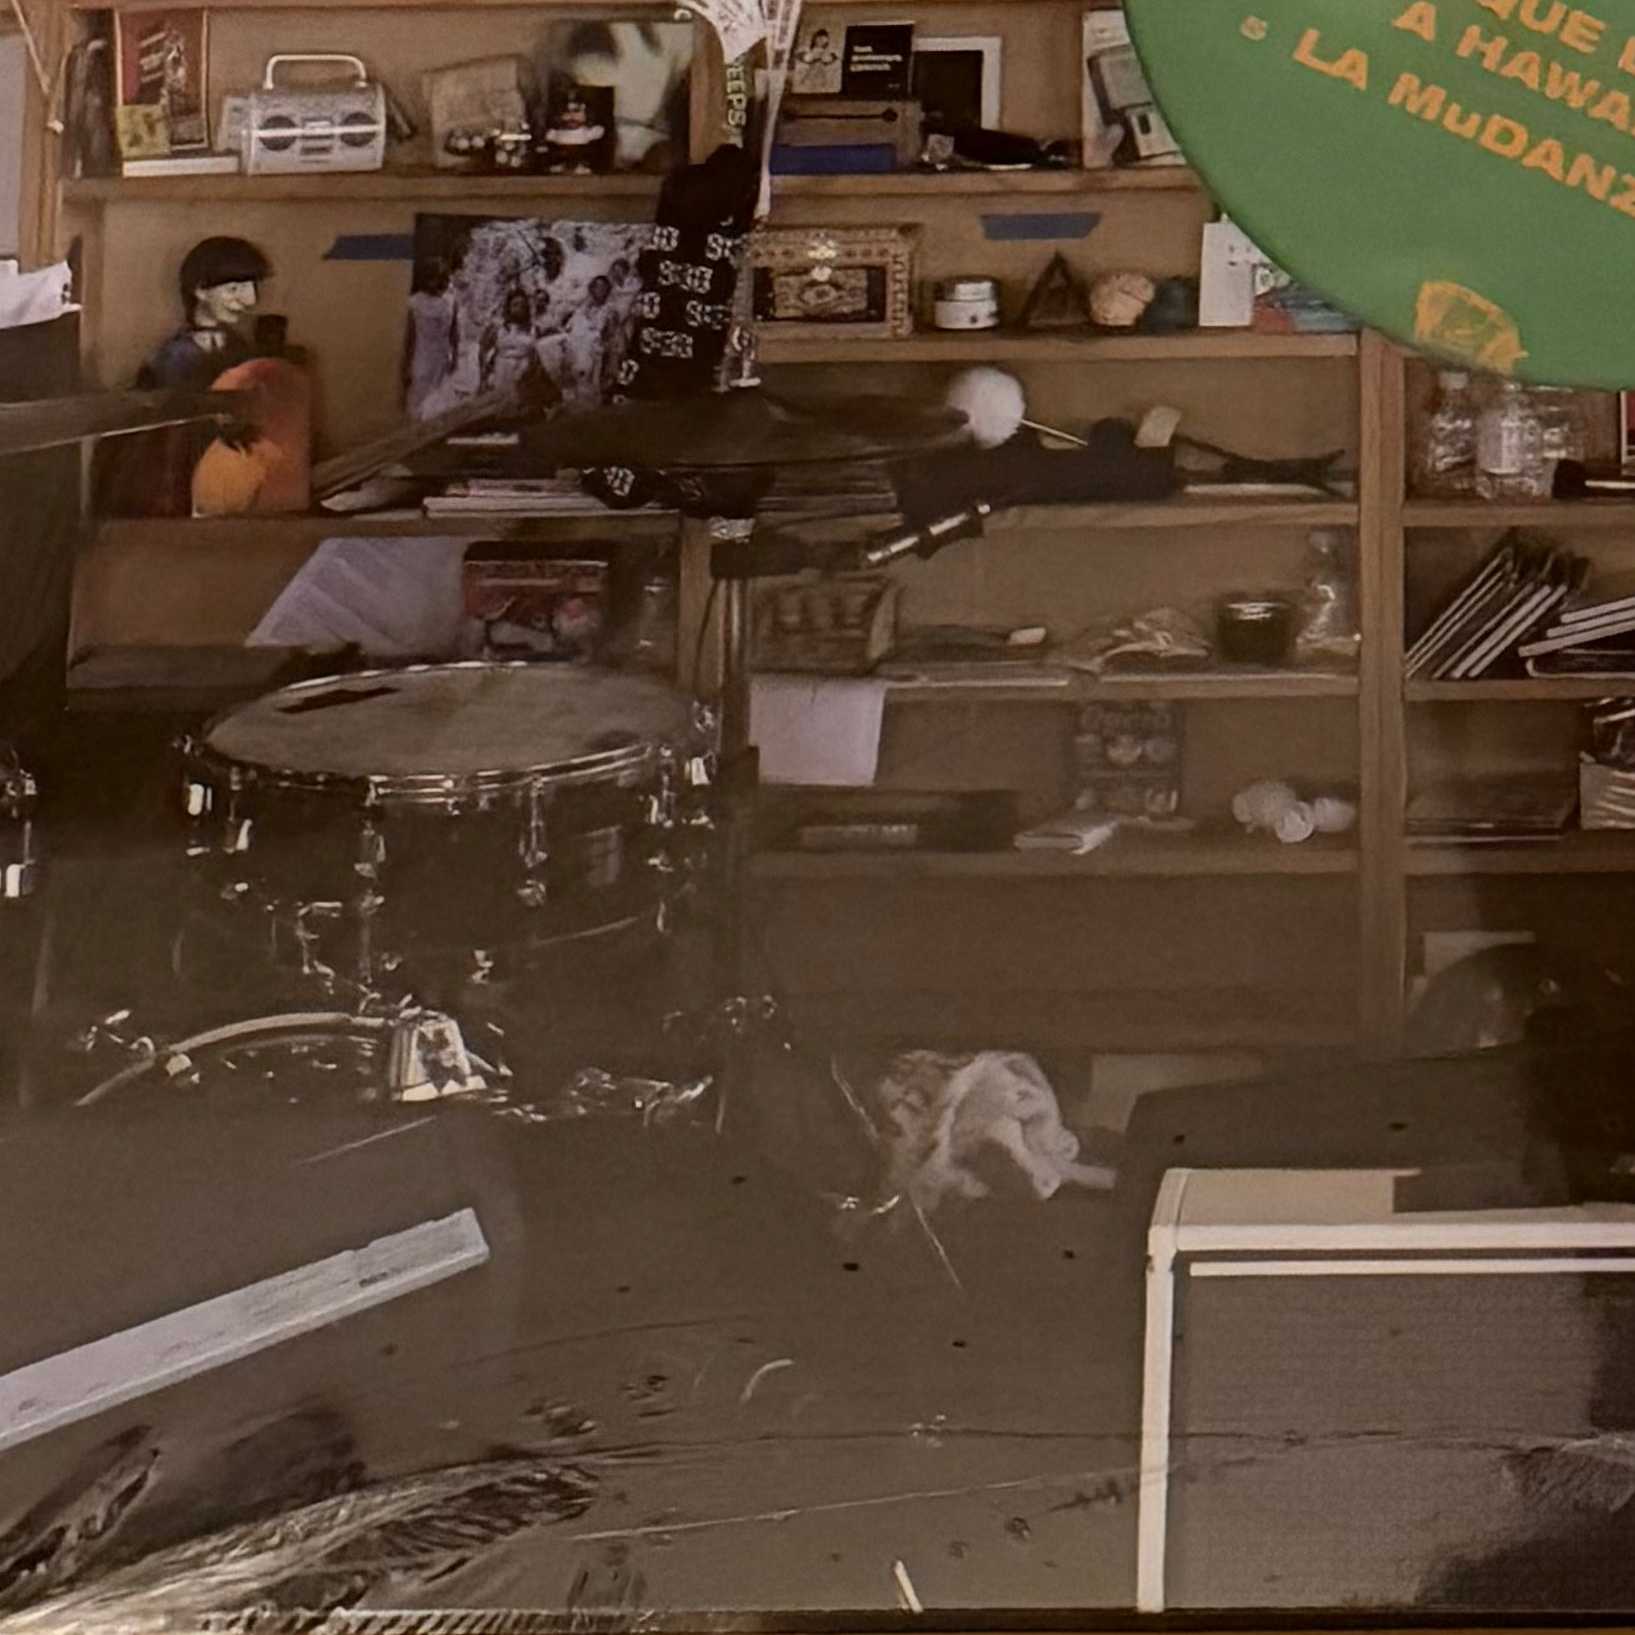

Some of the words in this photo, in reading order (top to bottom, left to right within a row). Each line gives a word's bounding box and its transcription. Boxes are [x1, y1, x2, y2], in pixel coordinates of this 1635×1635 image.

[1390, 0, 1437, 43] A
[1291, 27, 1369, 92] LA
[725, 65, 747, 127] EEPS
